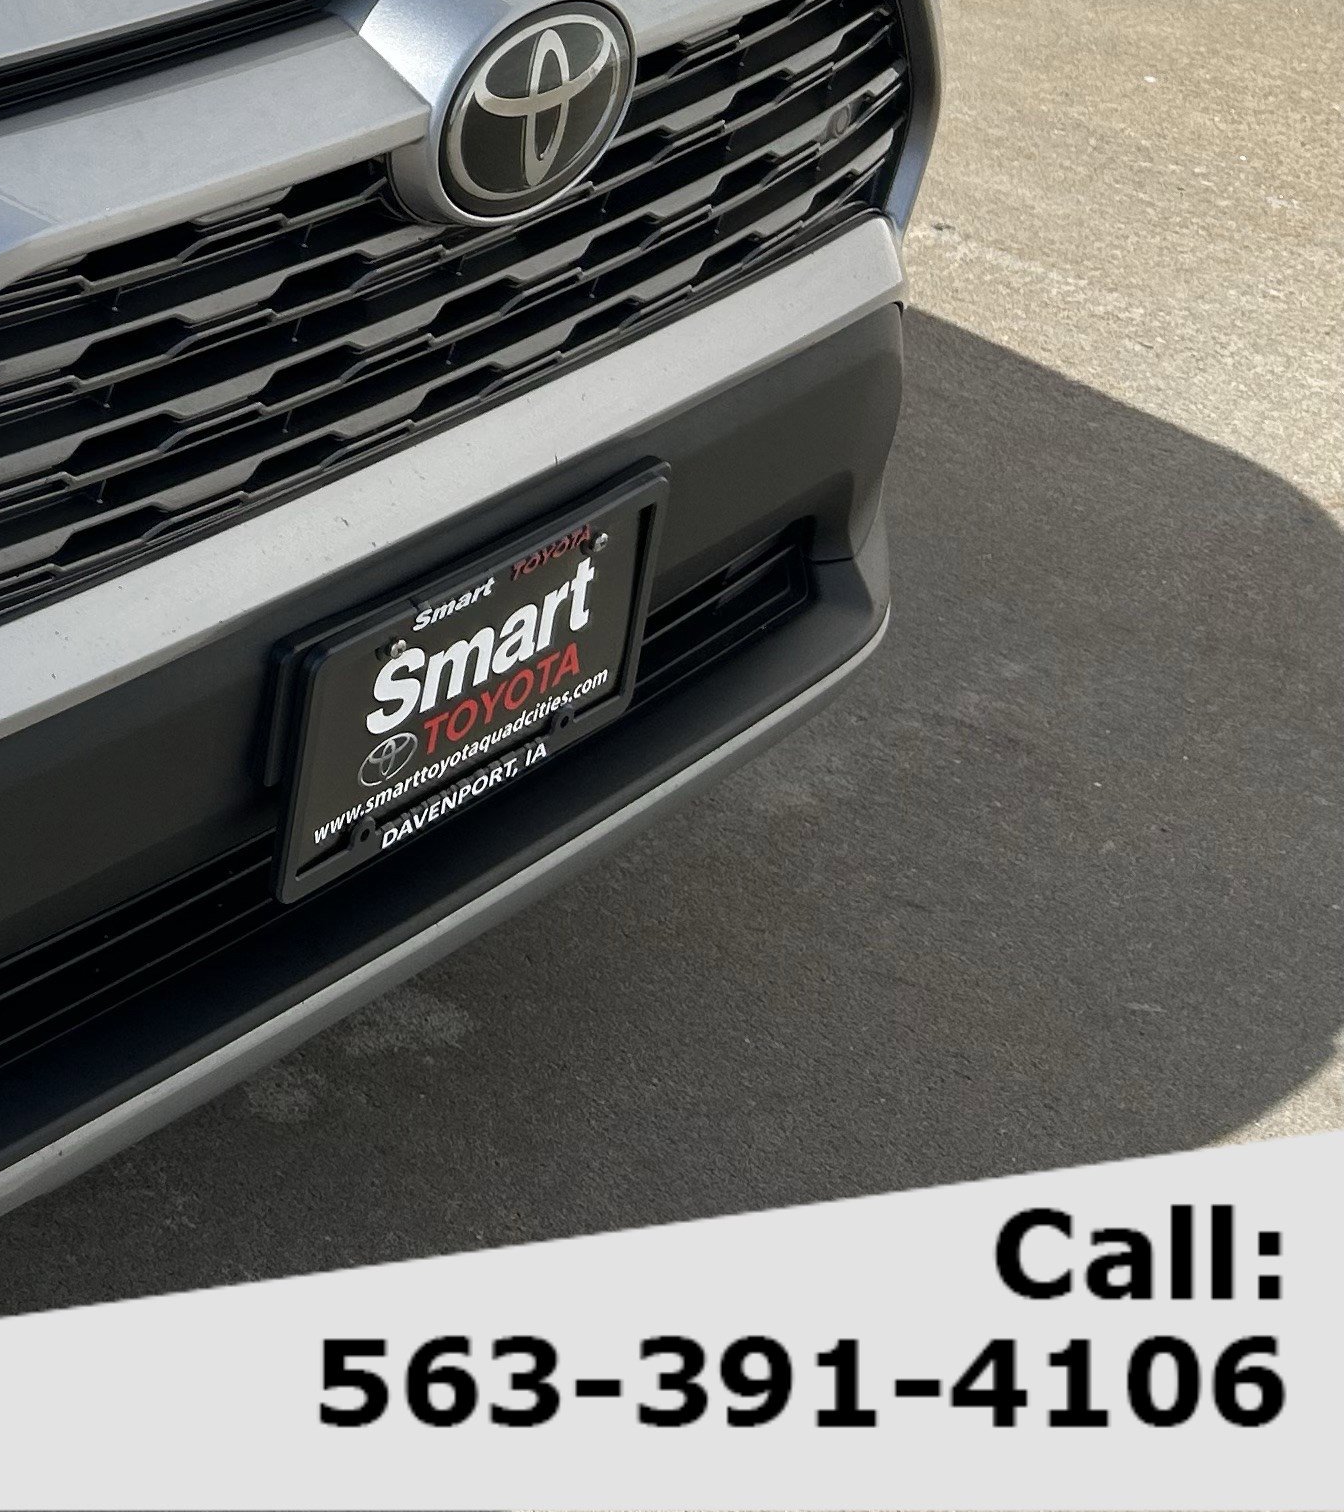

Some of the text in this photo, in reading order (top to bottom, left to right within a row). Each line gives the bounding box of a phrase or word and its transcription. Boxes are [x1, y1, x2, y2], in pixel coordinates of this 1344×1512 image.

[413, 523, 592, 632] Smart TOYOTA
[366, 557, 596, 736] Smart
[423, 642, 582, 756] TOYOTA
[313, 668, 609, 845] www.smarttoyotaquadcities.com
[381, 742, 548, 850] DAVENPORT, IA
